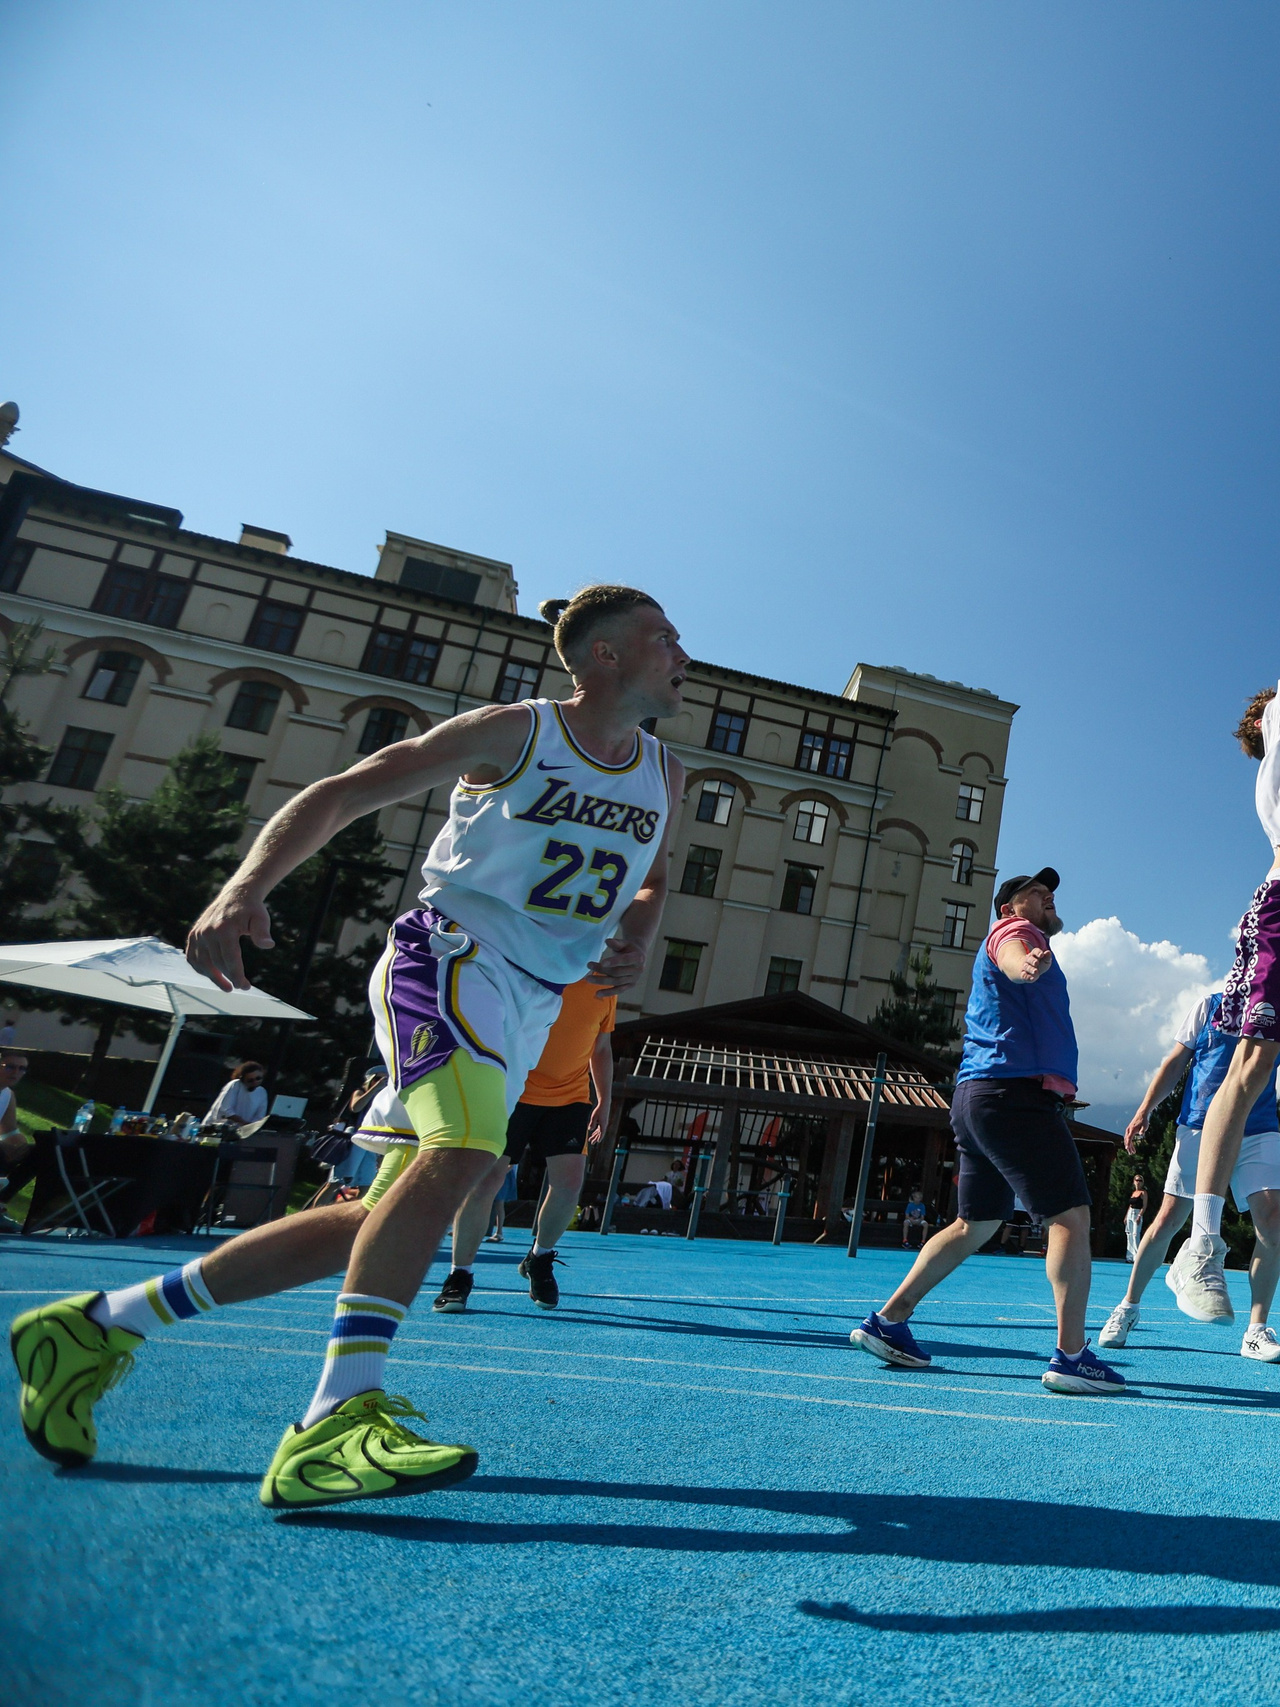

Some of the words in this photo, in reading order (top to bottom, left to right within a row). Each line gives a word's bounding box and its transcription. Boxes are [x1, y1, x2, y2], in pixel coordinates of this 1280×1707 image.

[512, 777, 660, 845] LAKERS
[523, 837, 630, 924] 23
[1076, 1362, 1106, 1380] HOKA
